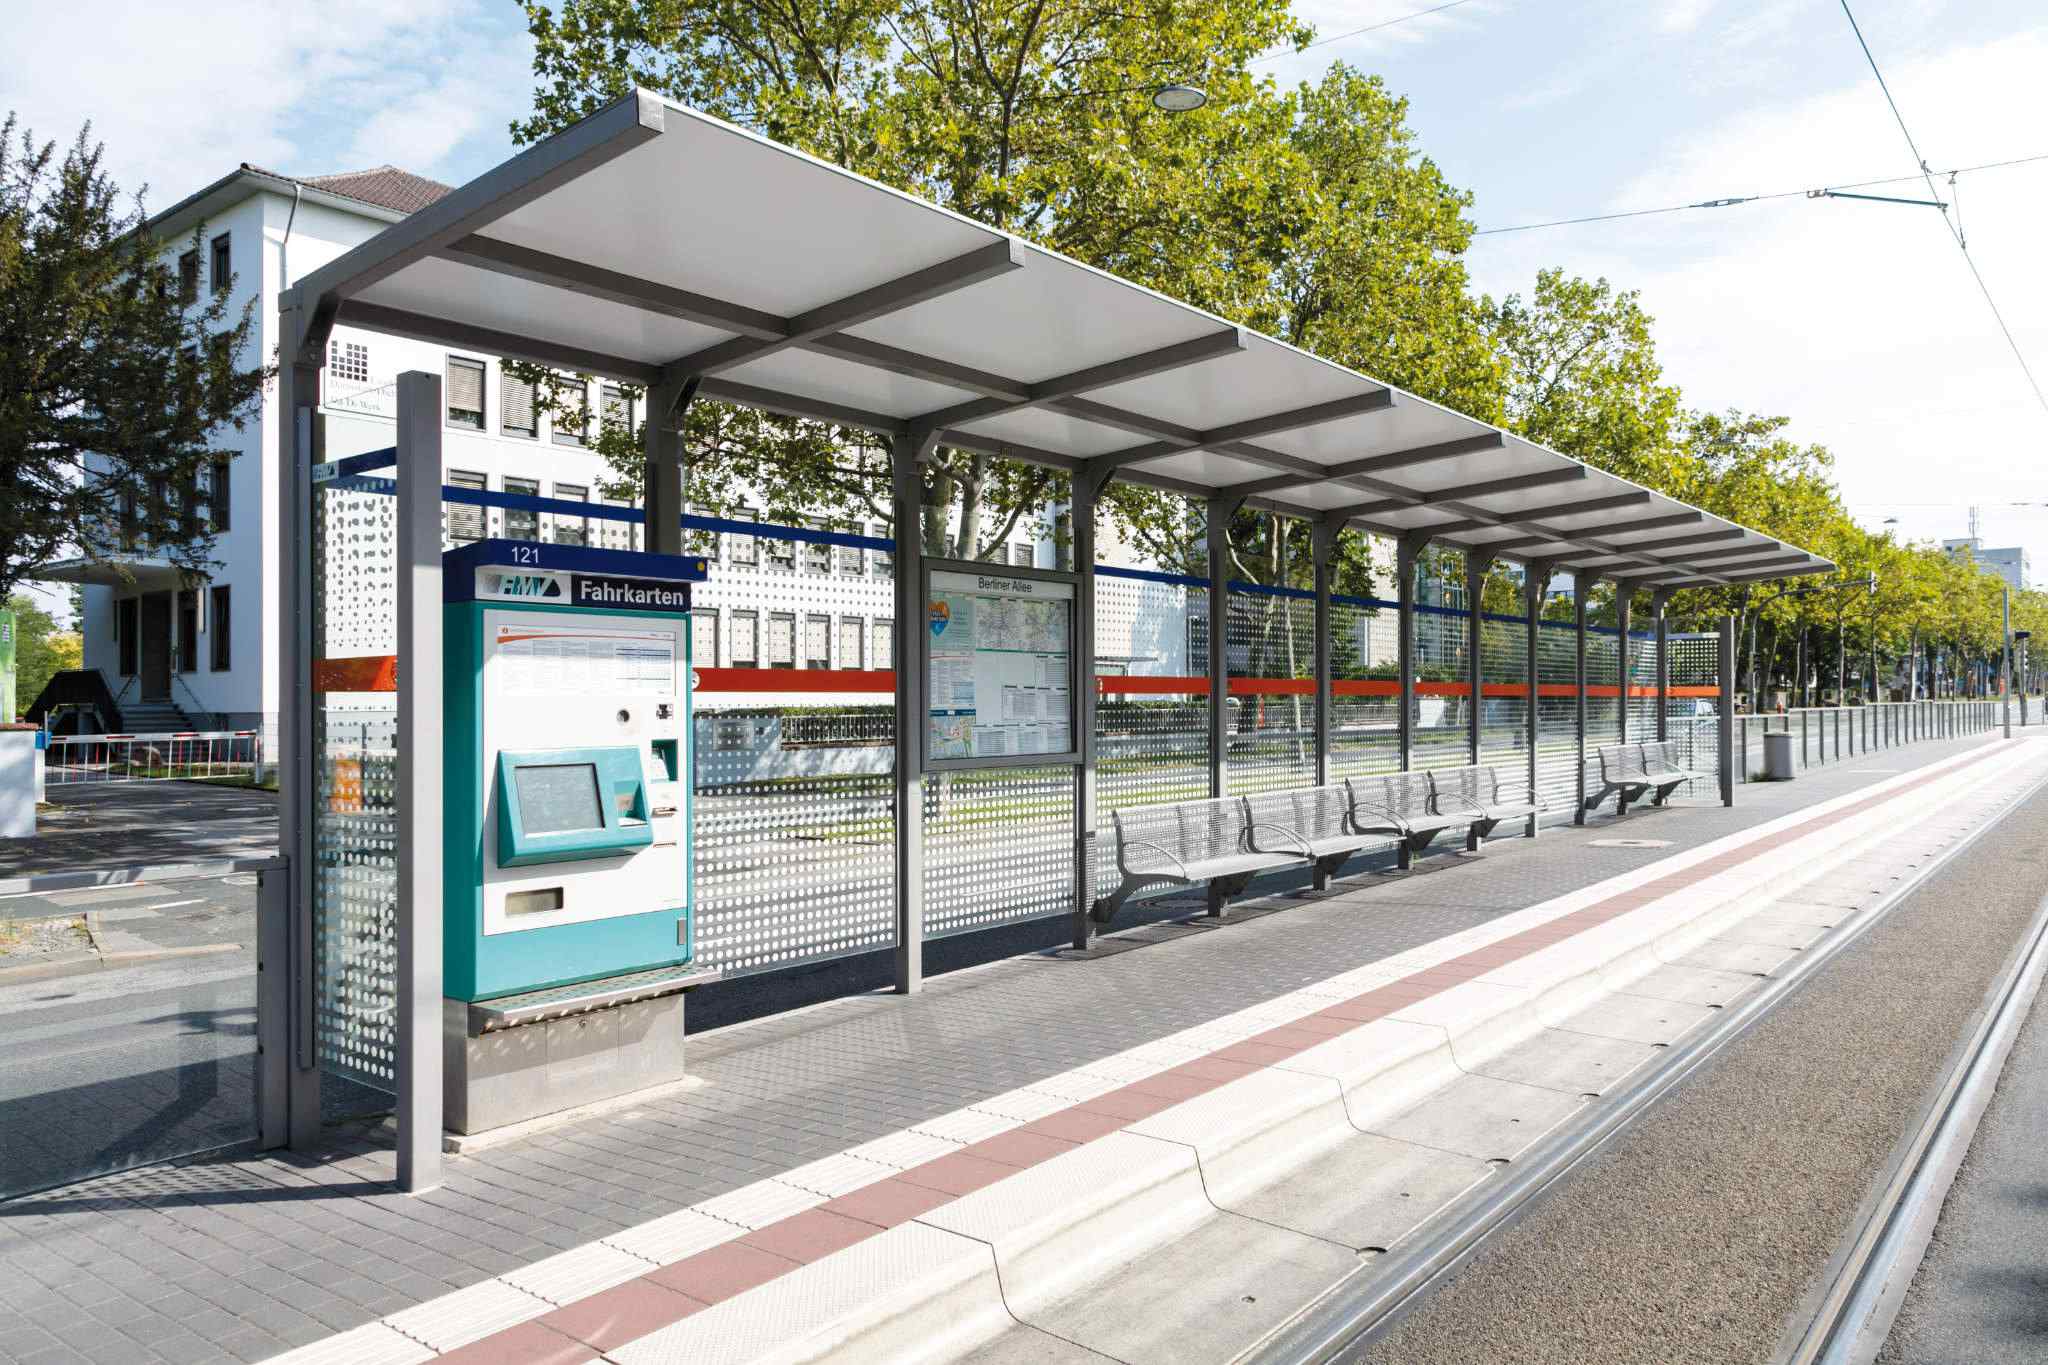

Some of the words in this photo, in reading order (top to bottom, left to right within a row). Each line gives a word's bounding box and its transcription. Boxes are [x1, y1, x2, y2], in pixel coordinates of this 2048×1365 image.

[511, 546, 540, 563] 121
[580, 580, 684, 606] Fahrkarten
[978, 576, 1010, 592] Berliner
[1012, 580, 1032, 593] Allee
